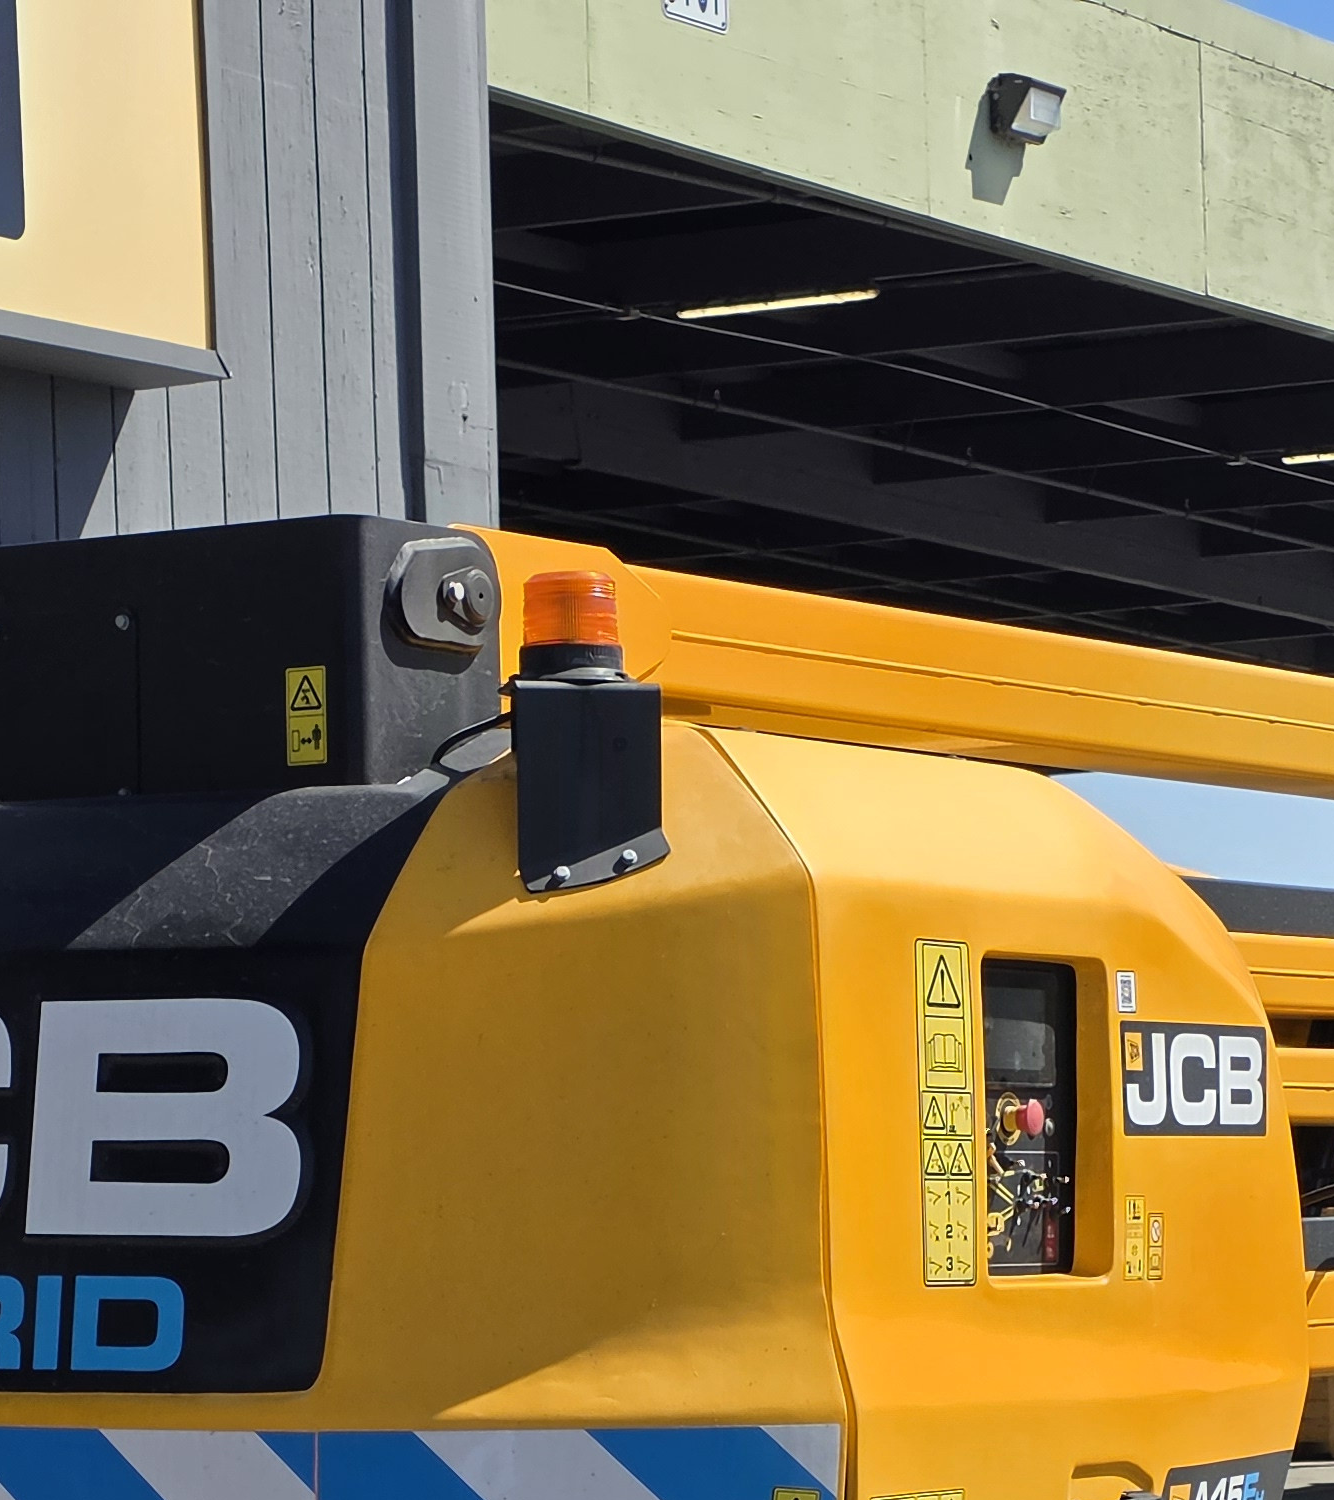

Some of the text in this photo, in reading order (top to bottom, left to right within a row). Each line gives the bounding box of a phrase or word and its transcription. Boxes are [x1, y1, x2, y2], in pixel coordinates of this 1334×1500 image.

[1126, 1033, 1264, 1126] JCB
[944, 1190, 953, 1206] 1
[945, 1225, 954, 1239] 2
[945, 1257, 954, 1271] 3
